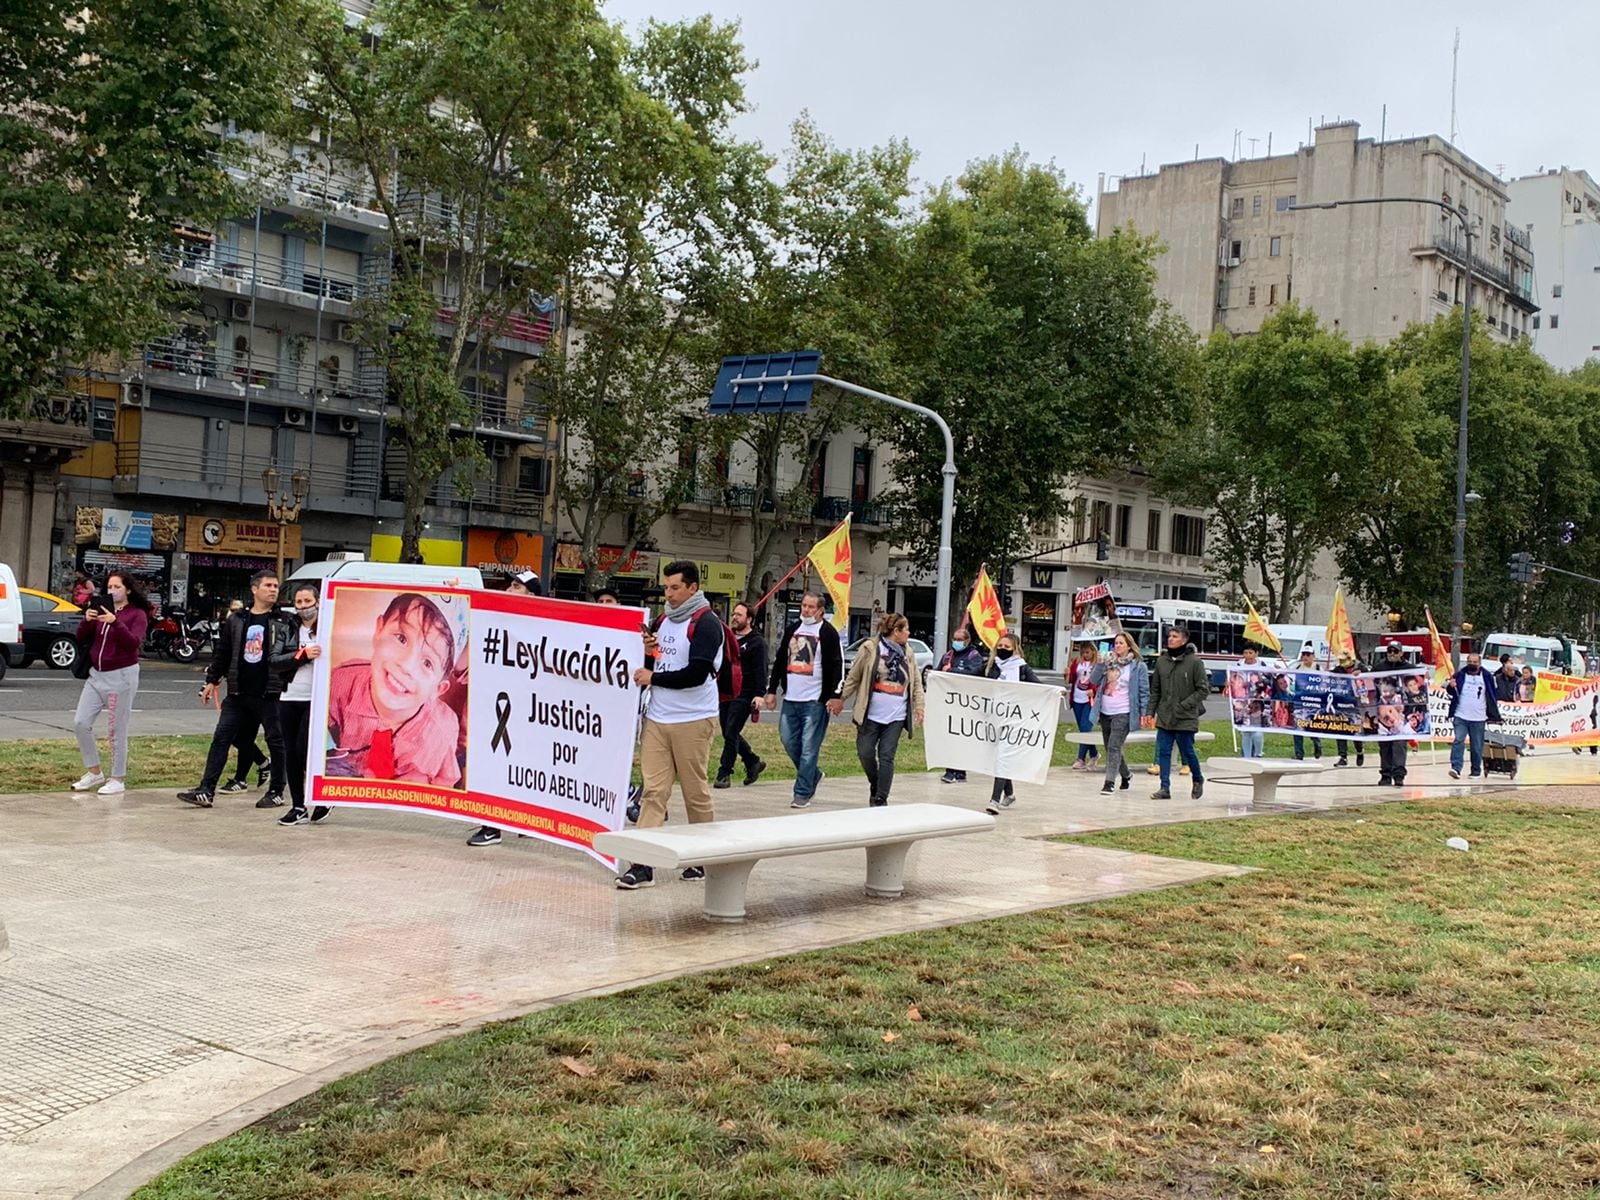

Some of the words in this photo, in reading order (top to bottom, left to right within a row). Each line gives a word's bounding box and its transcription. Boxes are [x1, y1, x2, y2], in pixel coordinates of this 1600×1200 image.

[478, 561, 532, 574] EMPANADAS
[528, 693, 602, 738] Justicia
[1571, 718, 1586, 733] 102
[1000, 725, 1050, 749] DUPUY
[552, 741, 579, 766] por
[321, 785, 448, 807] #BASTADEFALSASDENUNCIAS
[508, 764, 547, 793] LUCIO
[549, 773, 581, 802] ABEL
[583, 782, 618, 816] DUPUY
